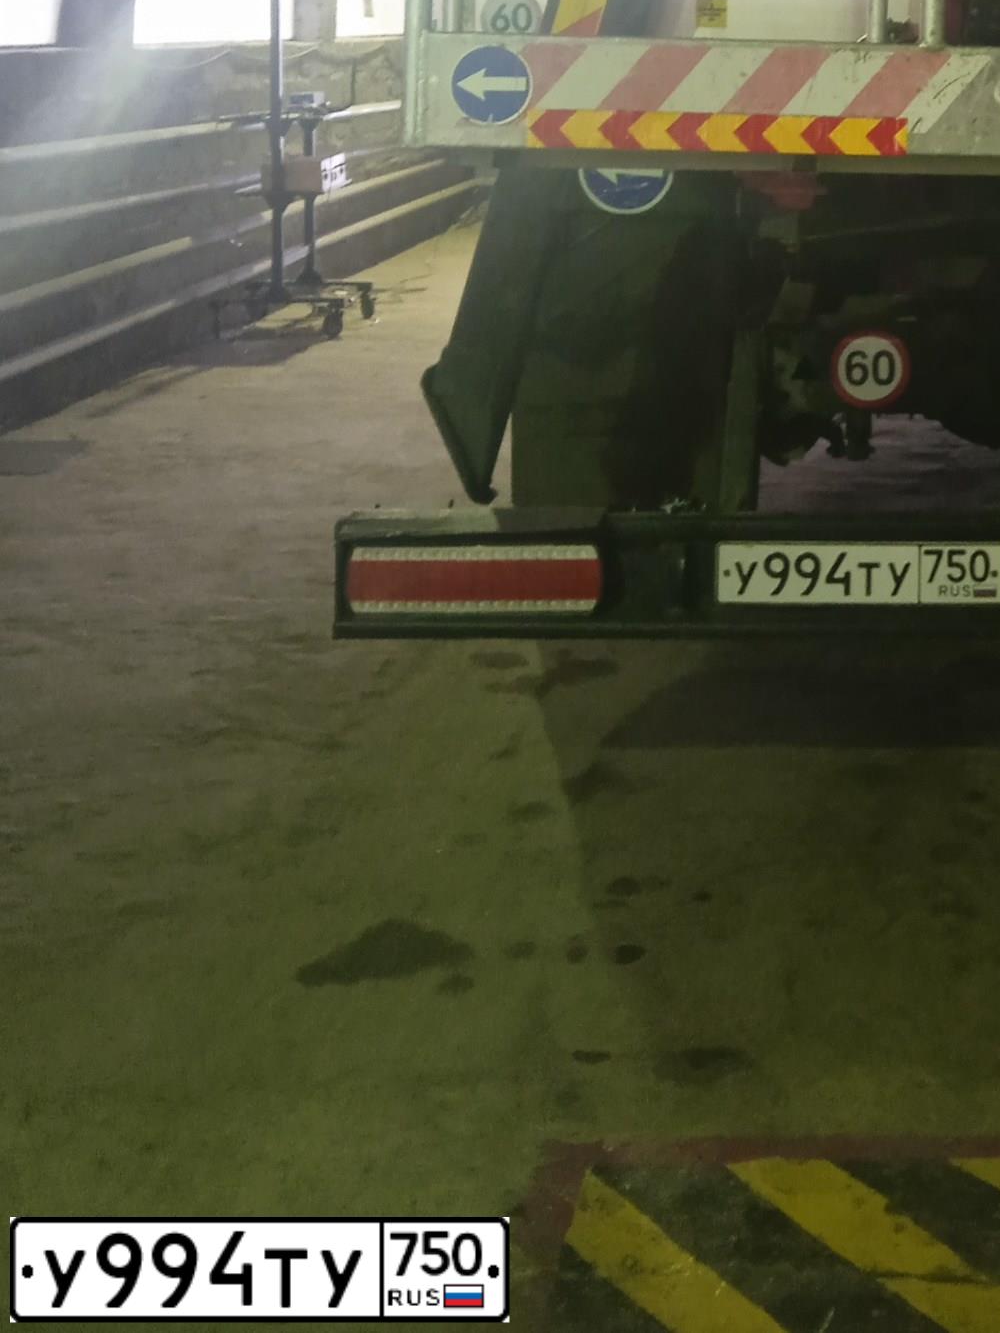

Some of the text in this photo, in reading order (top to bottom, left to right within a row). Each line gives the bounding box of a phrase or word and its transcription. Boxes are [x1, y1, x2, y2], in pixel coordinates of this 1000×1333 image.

[491, 2, 532, 32] 60
[845, 349, 896, 386] 60
[735, 551, 911, 596] У994ТУ
[923, 549, 991, 583] 750
[938, 585, 971, 597] RUS
